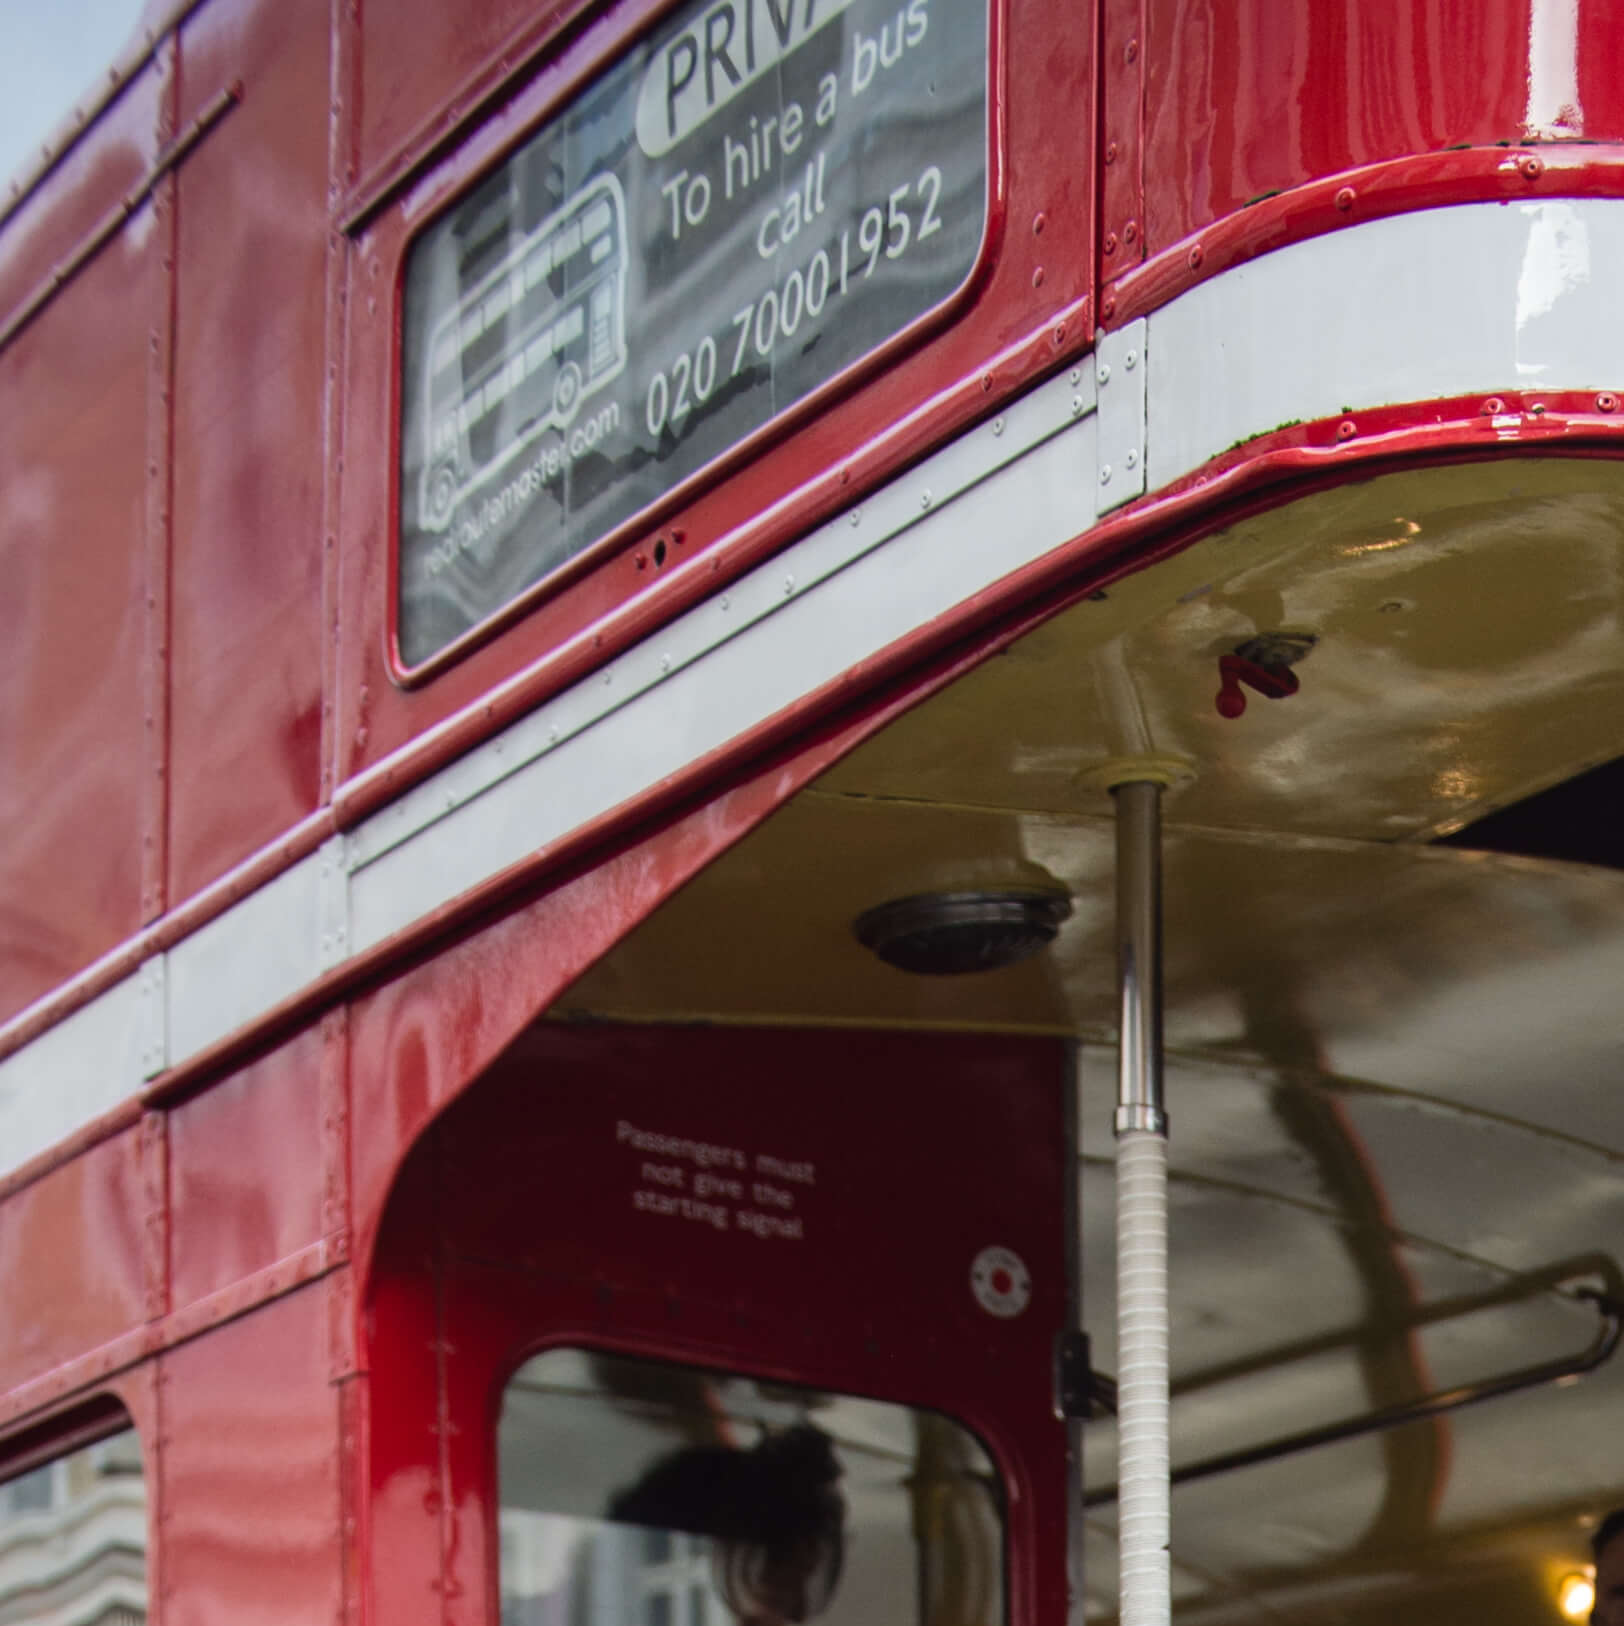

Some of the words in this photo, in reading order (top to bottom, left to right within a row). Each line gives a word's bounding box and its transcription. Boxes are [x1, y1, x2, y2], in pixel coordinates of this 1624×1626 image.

[661, 170, 711, 240] To
[726, 103, 803, 199] hire
[816, 72, 837, 127] a
[852, 0, 928, 97] bus
[758, 152, 825, 258] call
[647, 336, 716, 436] 020
[616, 1120, 746, 1168] Passengers
[756, 1154, 814, 1184] must
[642, 1162, 684, 1188] not
[694, 1173, 743, 1200] give
[753, 1182, 793, 1210] the
[633, 1190, 728, 1230] starting
[736, 1210, 803, 1239] signal
